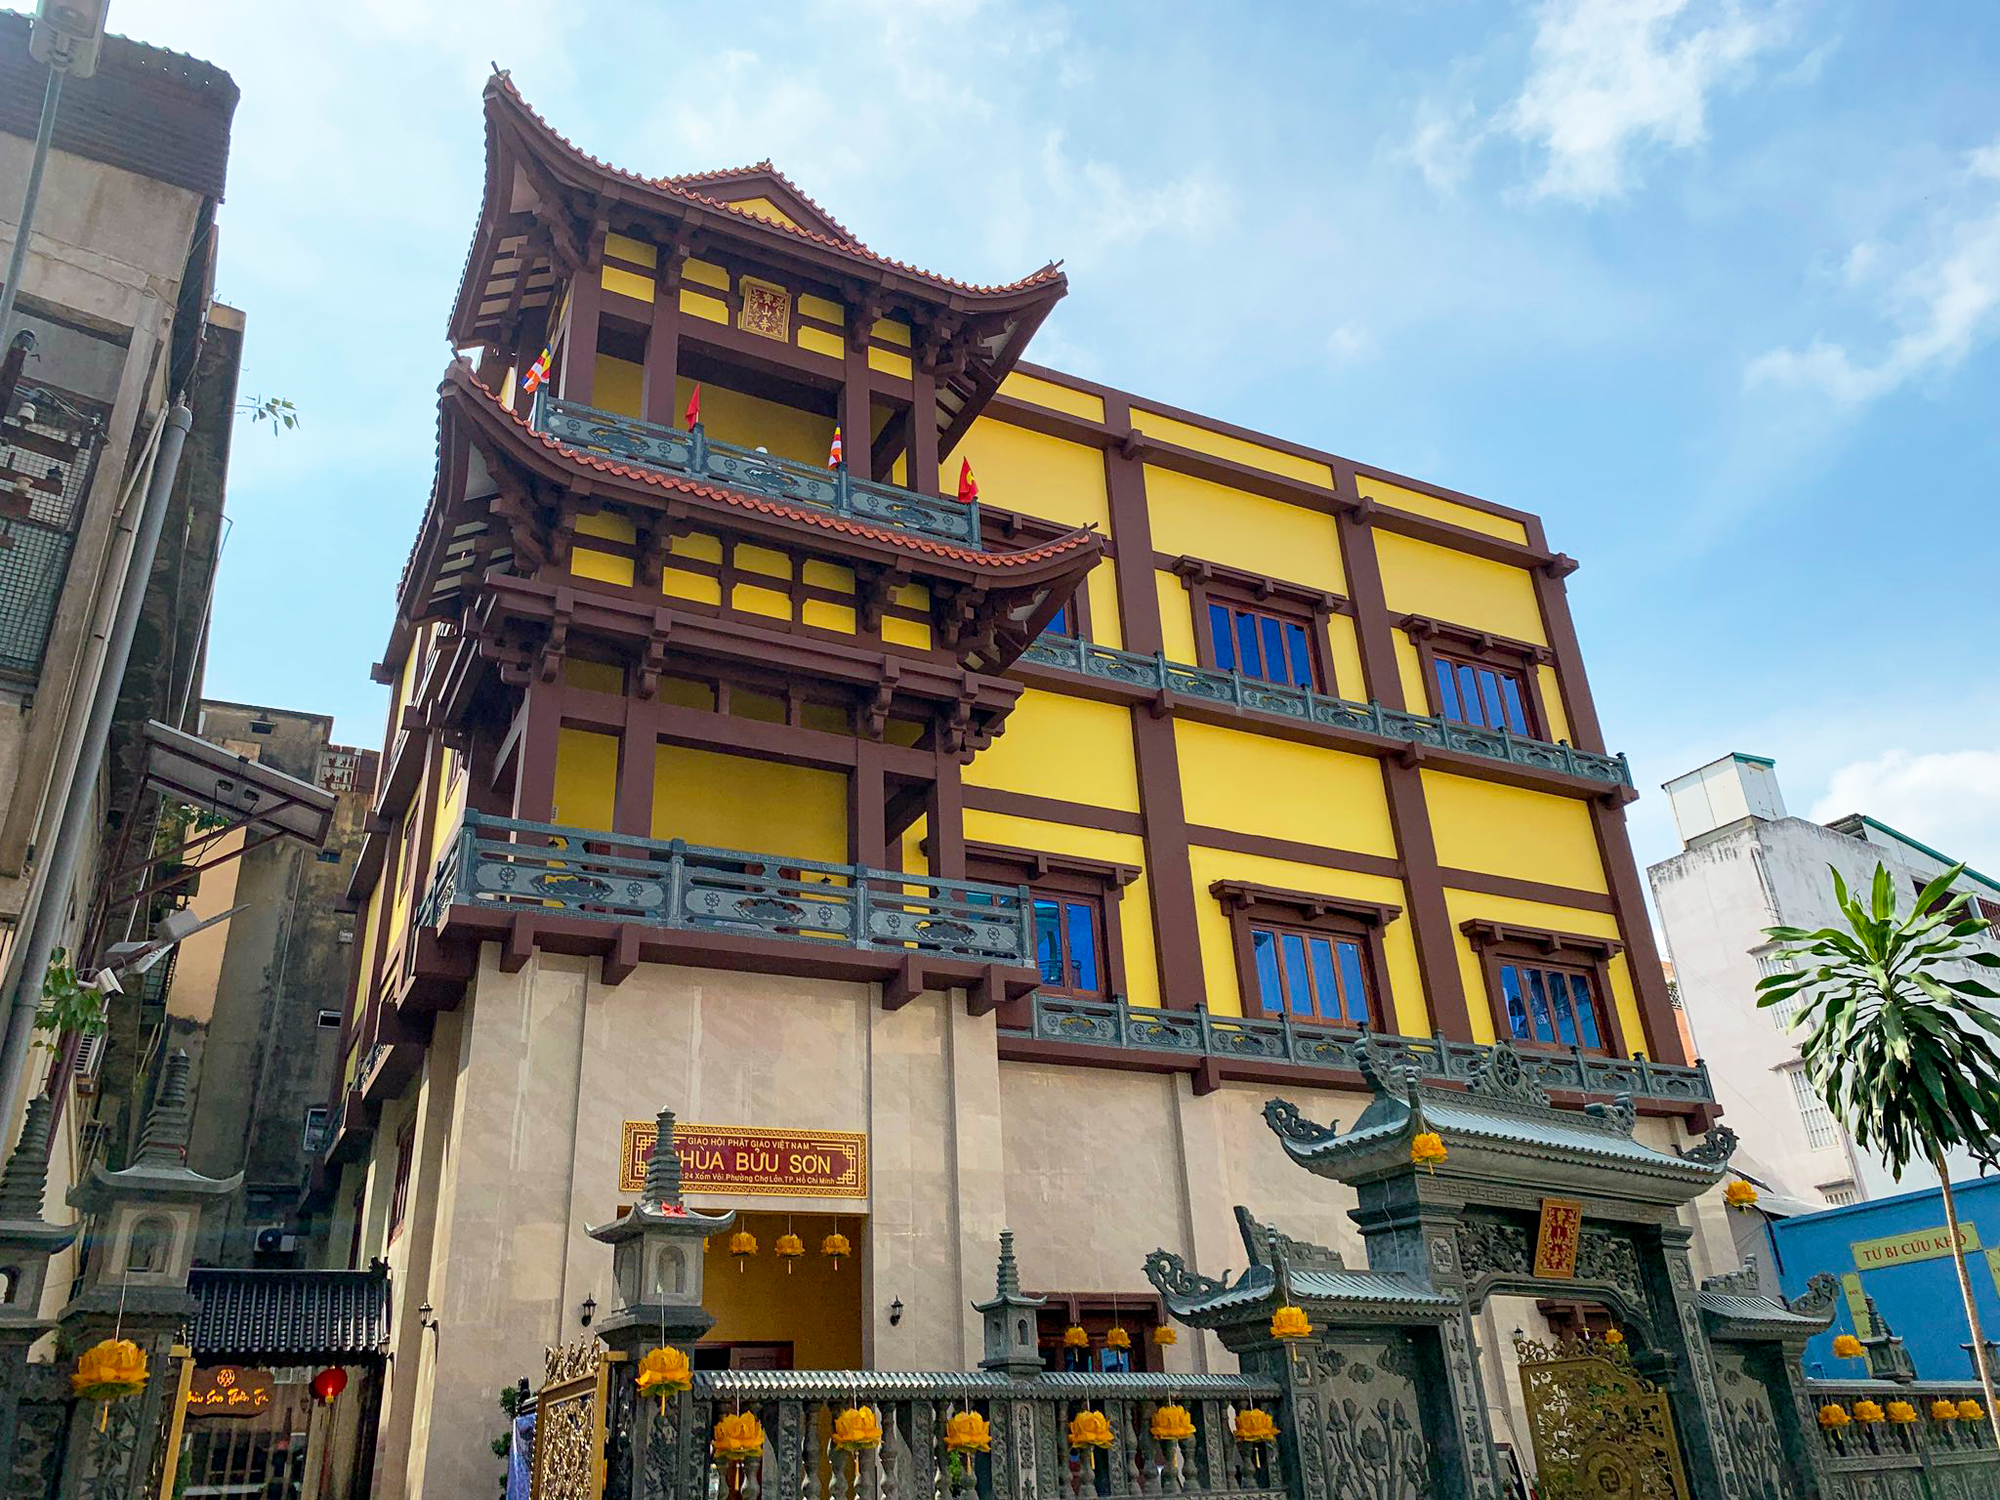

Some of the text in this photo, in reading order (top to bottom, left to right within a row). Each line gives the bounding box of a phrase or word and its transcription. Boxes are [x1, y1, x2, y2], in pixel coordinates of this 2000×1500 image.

[687, 1136, 810, 1151] GIÁO HỘI PHẬT GIÁO VIỆT NAM
[675, 1145, 831, 1175] HÙA BỬU SƠN
[1884, 1245, 1899, 1259] BI
[1901, 1238, 1931, 1255] CỨU
